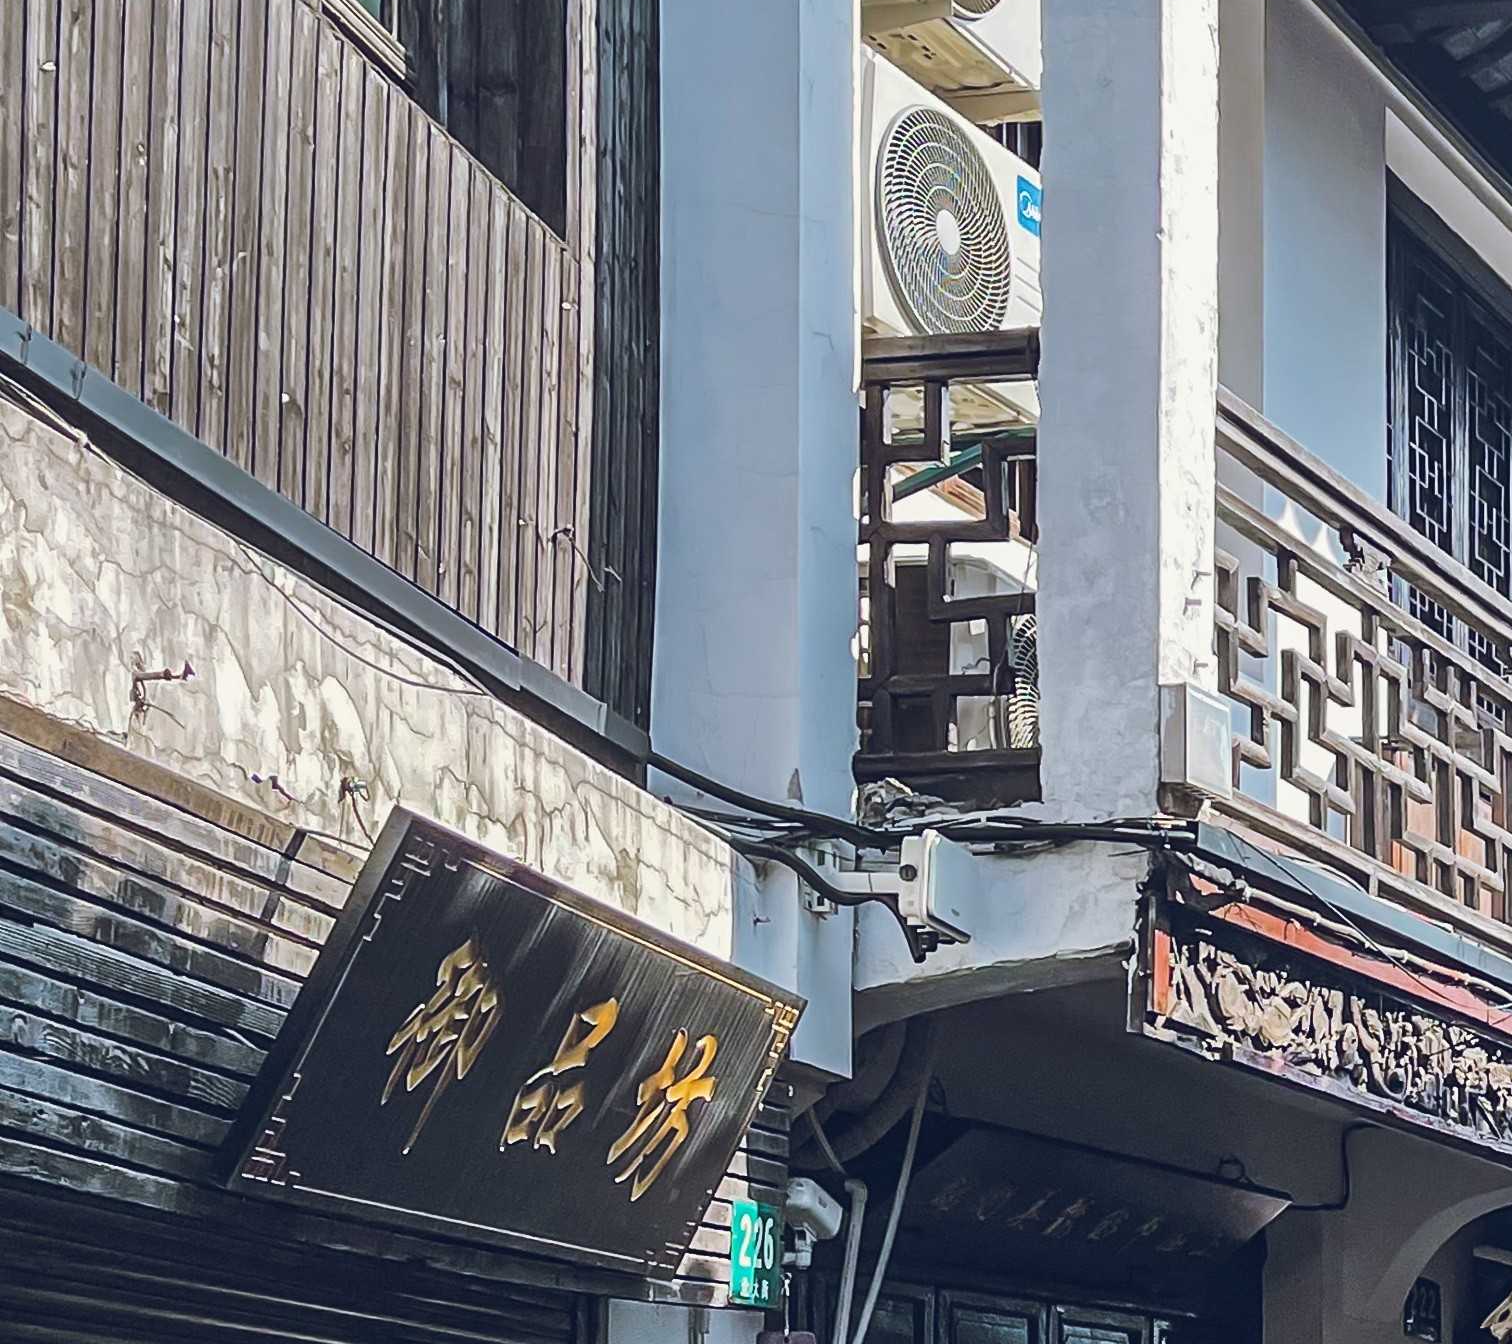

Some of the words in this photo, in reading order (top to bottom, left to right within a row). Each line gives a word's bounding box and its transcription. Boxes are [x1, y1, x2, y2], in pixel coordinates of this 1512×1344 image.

[380, 938, 718, 1203] 御品坊
[739, 1213, 775, 1270] 226
